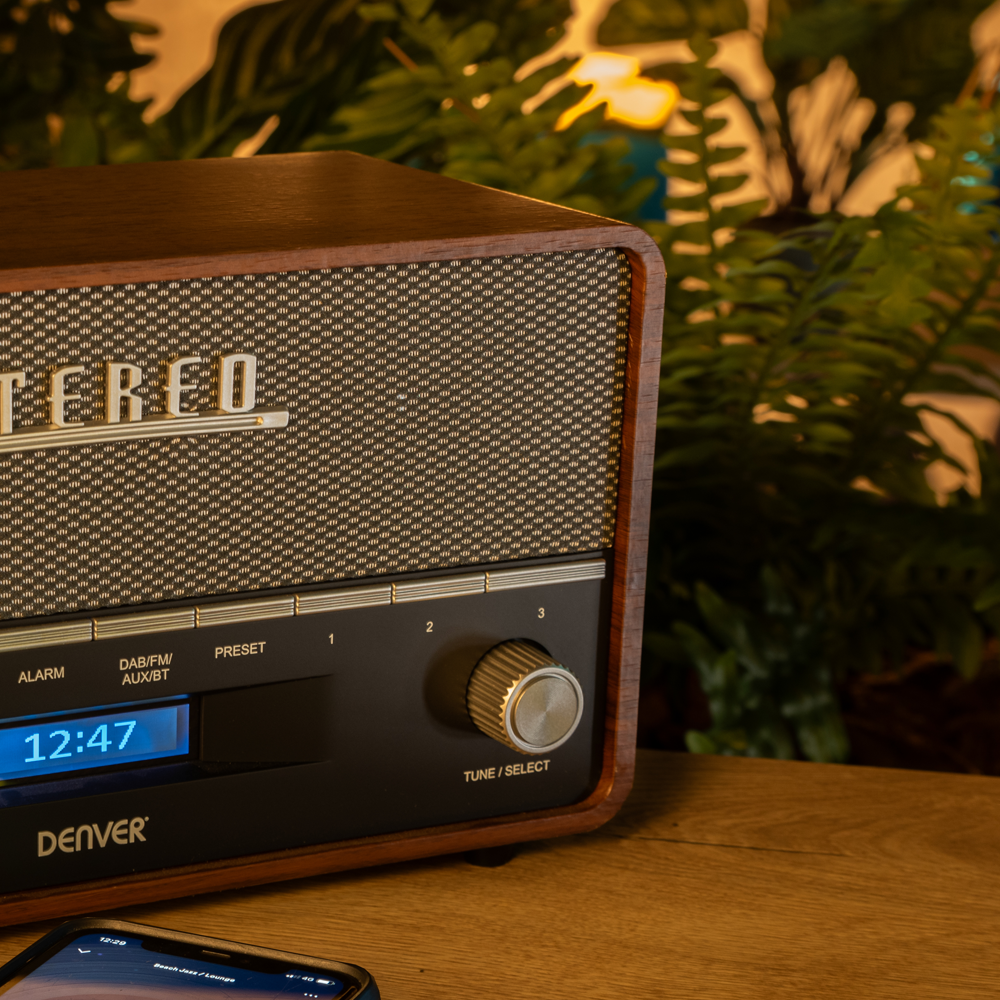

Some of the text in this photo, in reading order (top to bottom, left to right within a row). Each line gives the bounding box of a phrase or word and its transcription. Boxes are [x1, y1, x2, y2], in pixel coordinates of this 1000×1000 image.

[536, 607, 545, 619] 3
[425, 621, 434, 633] 2
[327, 633, 335, 645] 1
[214, 641, 267, 660] PRESET
[119, 653, 173, 671] DAB/FM/
[17, 666, 65, 683] ALARM
[121, 668, 170, 685] AUX/BT
[24, 720, 137, 763] 12:47
[463, 767, 496, 782] TUNE
[504, 759, 551, 777] SELECT
[37, 816, 148, 857] DENVER
[99, 936, 127, 946] 12:29
[153, 962, 179, 973] Beach
[178, 967, 199, 977] Jazz
[204, 972, 236, 983] Lounge
